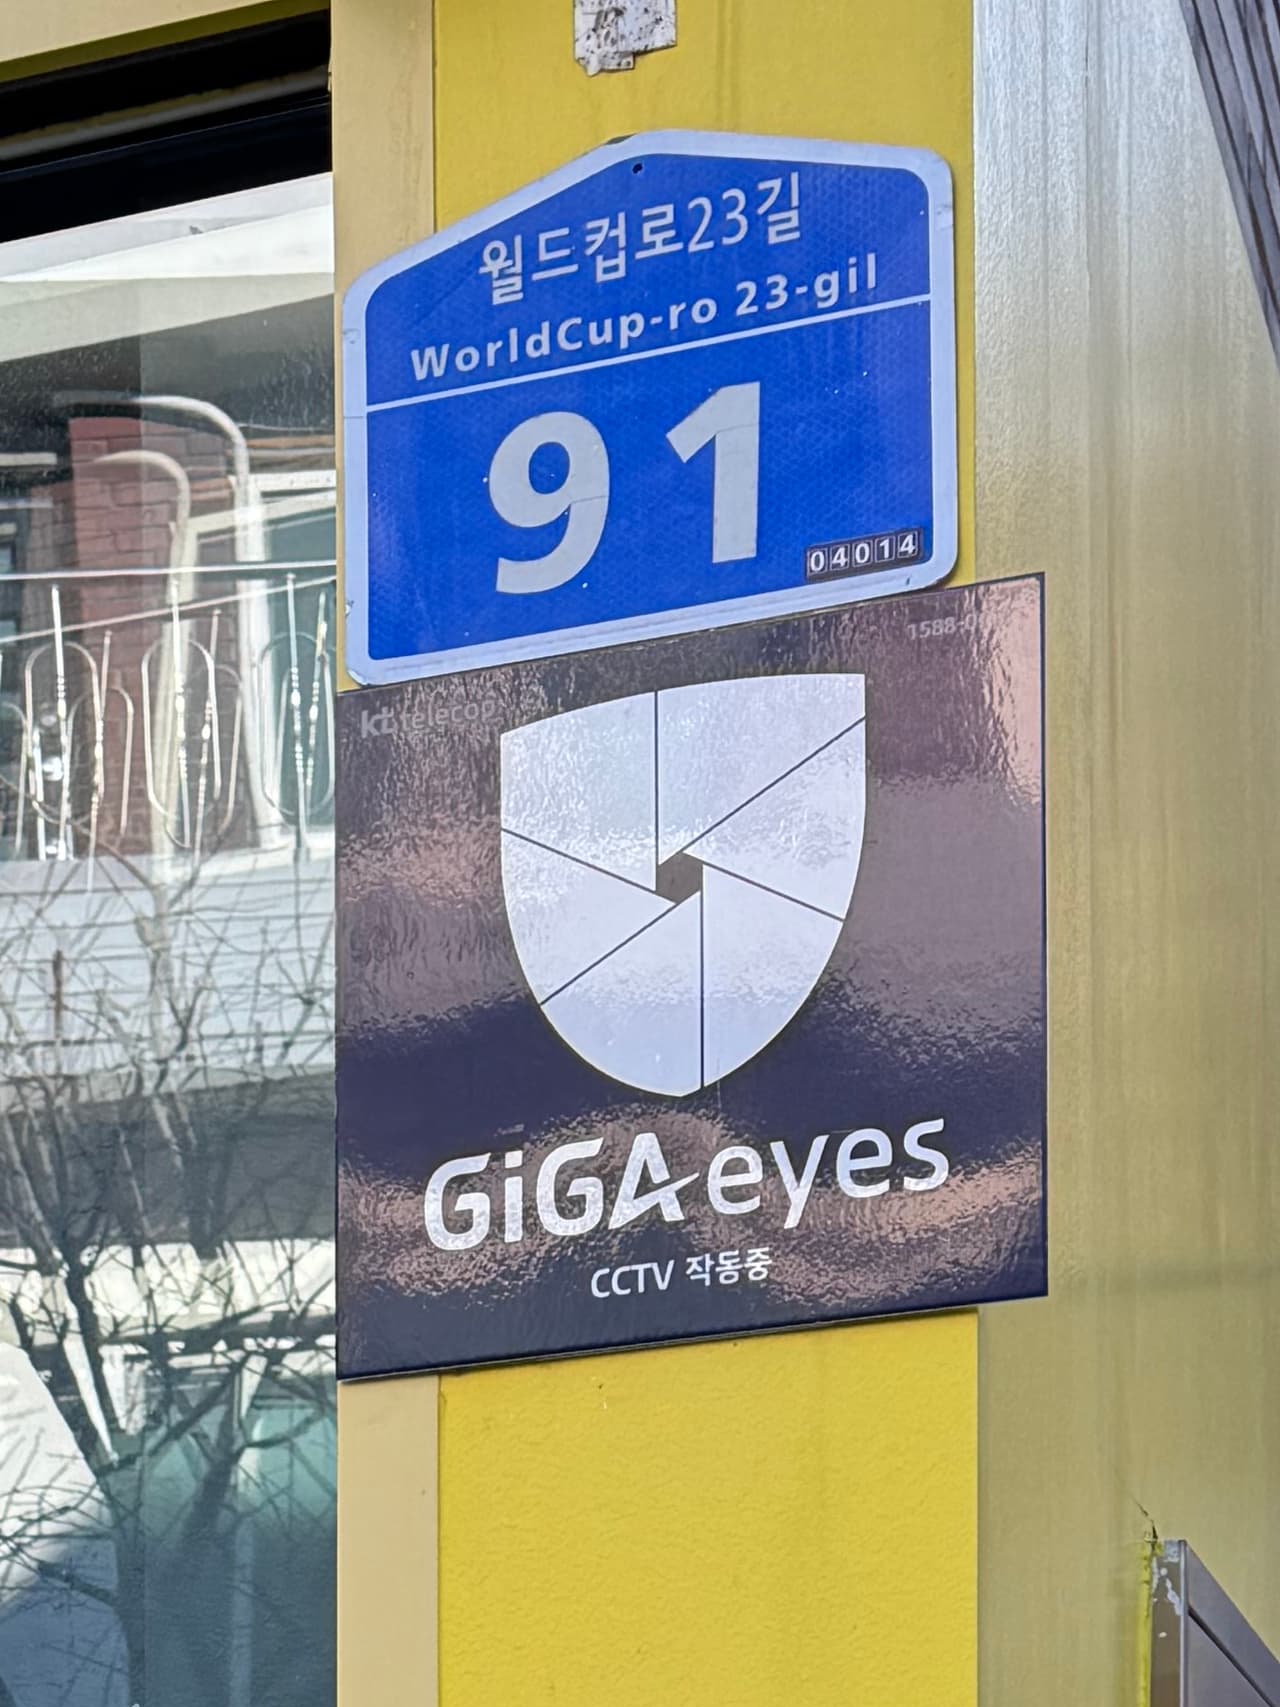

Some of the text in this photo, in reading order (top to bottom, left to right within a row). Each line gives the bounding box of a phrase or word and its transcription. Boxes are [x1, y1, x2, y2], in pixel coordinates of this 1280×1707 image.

[478, 171, 801, 306] 월드컵로23길
[409, 252, 878, 382] WorldCup-ro 23-gil
[487, 380, 762, 595] 91
[807, 532, 918, 575] 04014
[590, 1246, 773, 1299] CCTV 작동중
